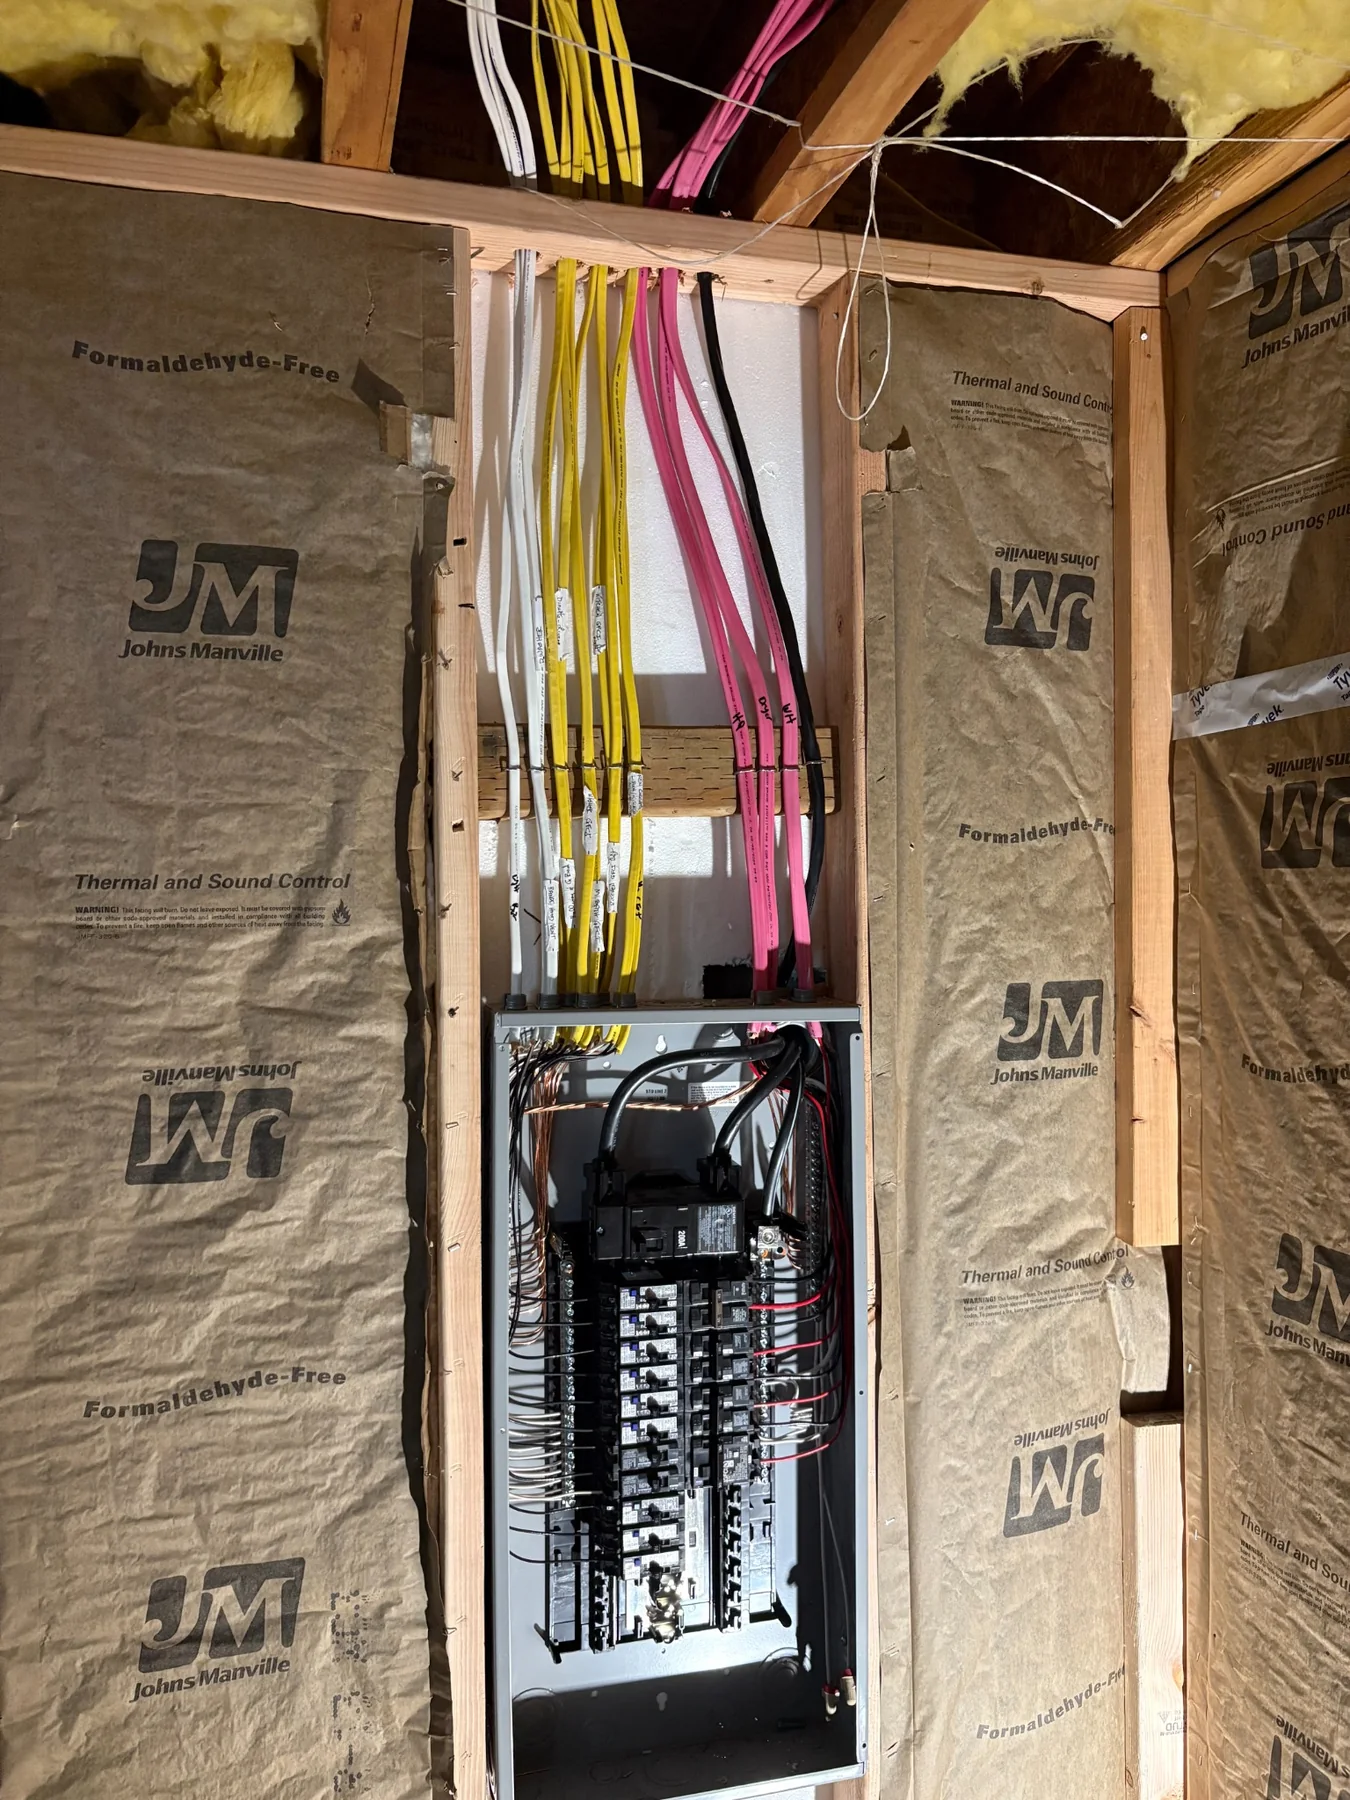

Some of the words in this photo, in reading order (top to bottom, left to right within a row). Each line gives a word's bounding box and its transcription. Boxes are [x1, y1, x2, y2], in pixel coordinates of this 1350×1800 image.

[72, 340, 340, 383] Formaldehyde-Free
[1241, 336, 1291, 369] Johns
[952, 370, 1012, 391] Thermal
[1014, 382, 1040, 397] and
[1042, 385, 1081, 405] Sound
[1271, 513, 1325, 541] Sound
[995, 546, 1058, 566] Manville
[1222, 529, 1267, 557] Control
[1060, 555, 1100, 570] Johns
[128, 539, 299, 638] JM
[984, 567, 1095, 650] JM
[118, 639, 187, 659] Johns
[190, 643, 284, 662] Manville
[1190, 684, 1212, 707] Tyve
[1266, 755, 1323, 777] Manville
[75, 874, 159, 890] Thermal
[164, 874, 203, 890] and
[208, 873, 273, 889] Sound
[278, 873, 350, 889] Control
[997, 979, 1104, 1061] JM
[142, 1065, 236, 1086] Manville
[239, 1061, 302, 1080] Johns
[990, 1067, 1038, 1085] Johns
[1040, 1062, 1098, 1080] Manville
[125, 1087, 293, 1186] JM
[961, 1265, 1022, 1283] Thermal
[1025, 1260, 1051, 1277] and
[1054, 1253, 1092, 1273] Sound
[1264, 1320, 1311, 1349] Johns
[83, 1366, 346, 1419] Formaldehyde-Free
[1074, 1408, 1111, 1430] Johns
[1013, 1422, 1073, 1448] Manville
[1003, 1432, 1105, 1538] JM
[1240, 1510, 1291, 1554] Thermal
[1293, 1548, 1318, 1571] and
[1321, 1563, 1350, 1592] Sou
[138, 1557, 305, 1673] JM
[129, 1673, 196, 1703] Johns
[198, 1657, 291, 1688] Manville
[1276, 1714, 1338, 1776] Manville
